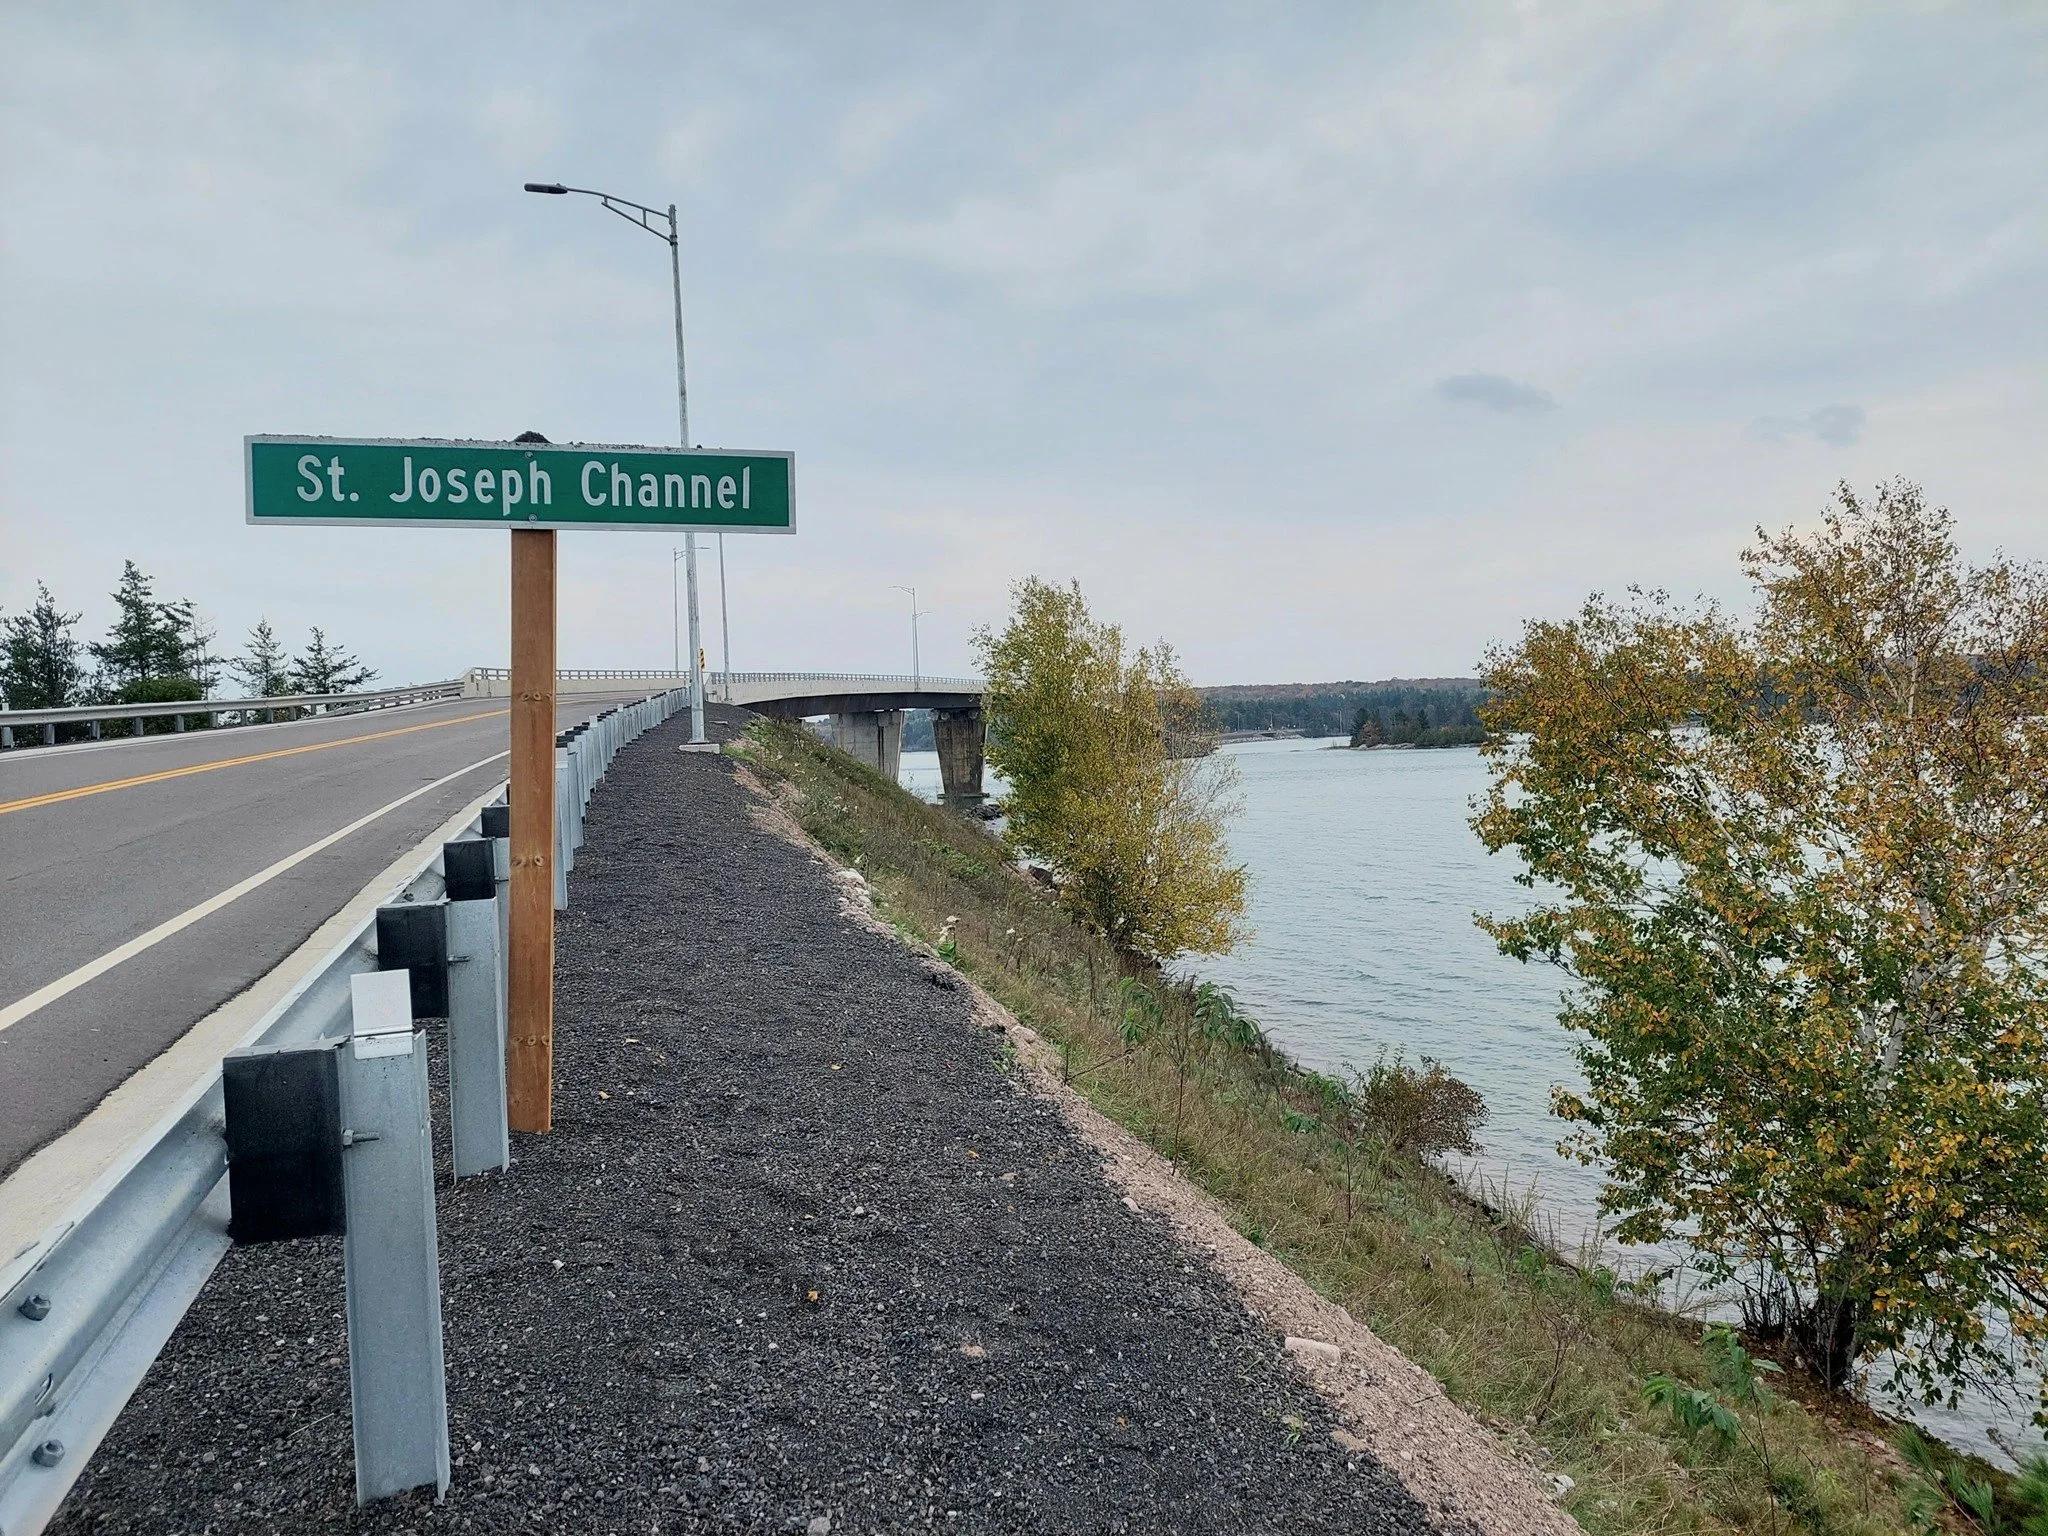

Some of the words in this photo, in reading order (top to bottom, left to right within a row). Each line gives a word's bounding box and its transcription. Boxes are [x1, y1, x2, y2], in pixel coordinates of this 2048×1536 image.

[297, 455, 359, 502] St.
[389, 456, 552, 516] Joseph
[581, 460, 750, 508] Channel
